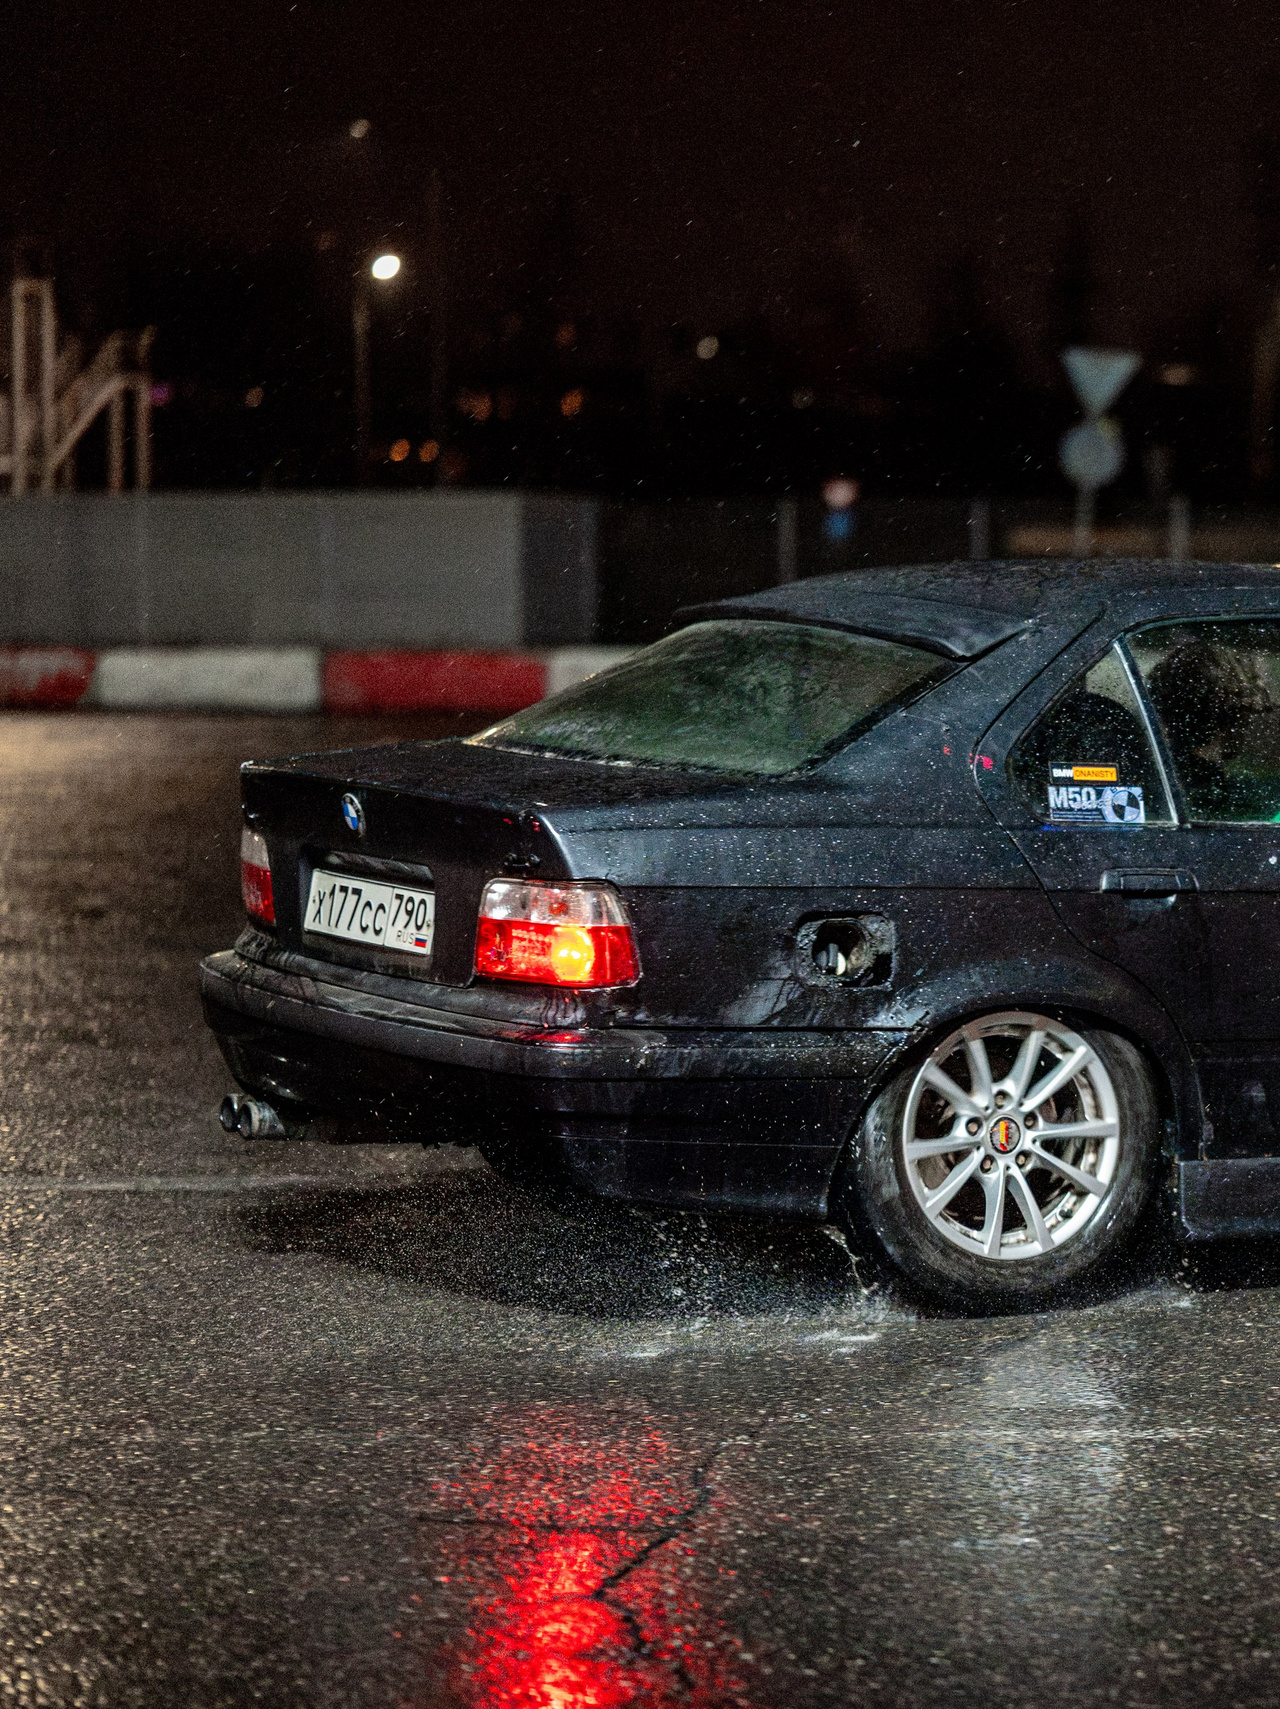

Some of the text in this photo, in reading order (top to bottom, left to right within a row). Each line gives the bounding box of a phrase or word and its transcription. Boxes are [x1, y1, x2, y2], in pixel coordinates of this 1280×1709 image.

[1075, 769, 1115, 778] ONANISTY
[1047, 786, 1098, 810] M50
[391, 892, 429, 932] 790
[395, 929, 416, 945] RUS
